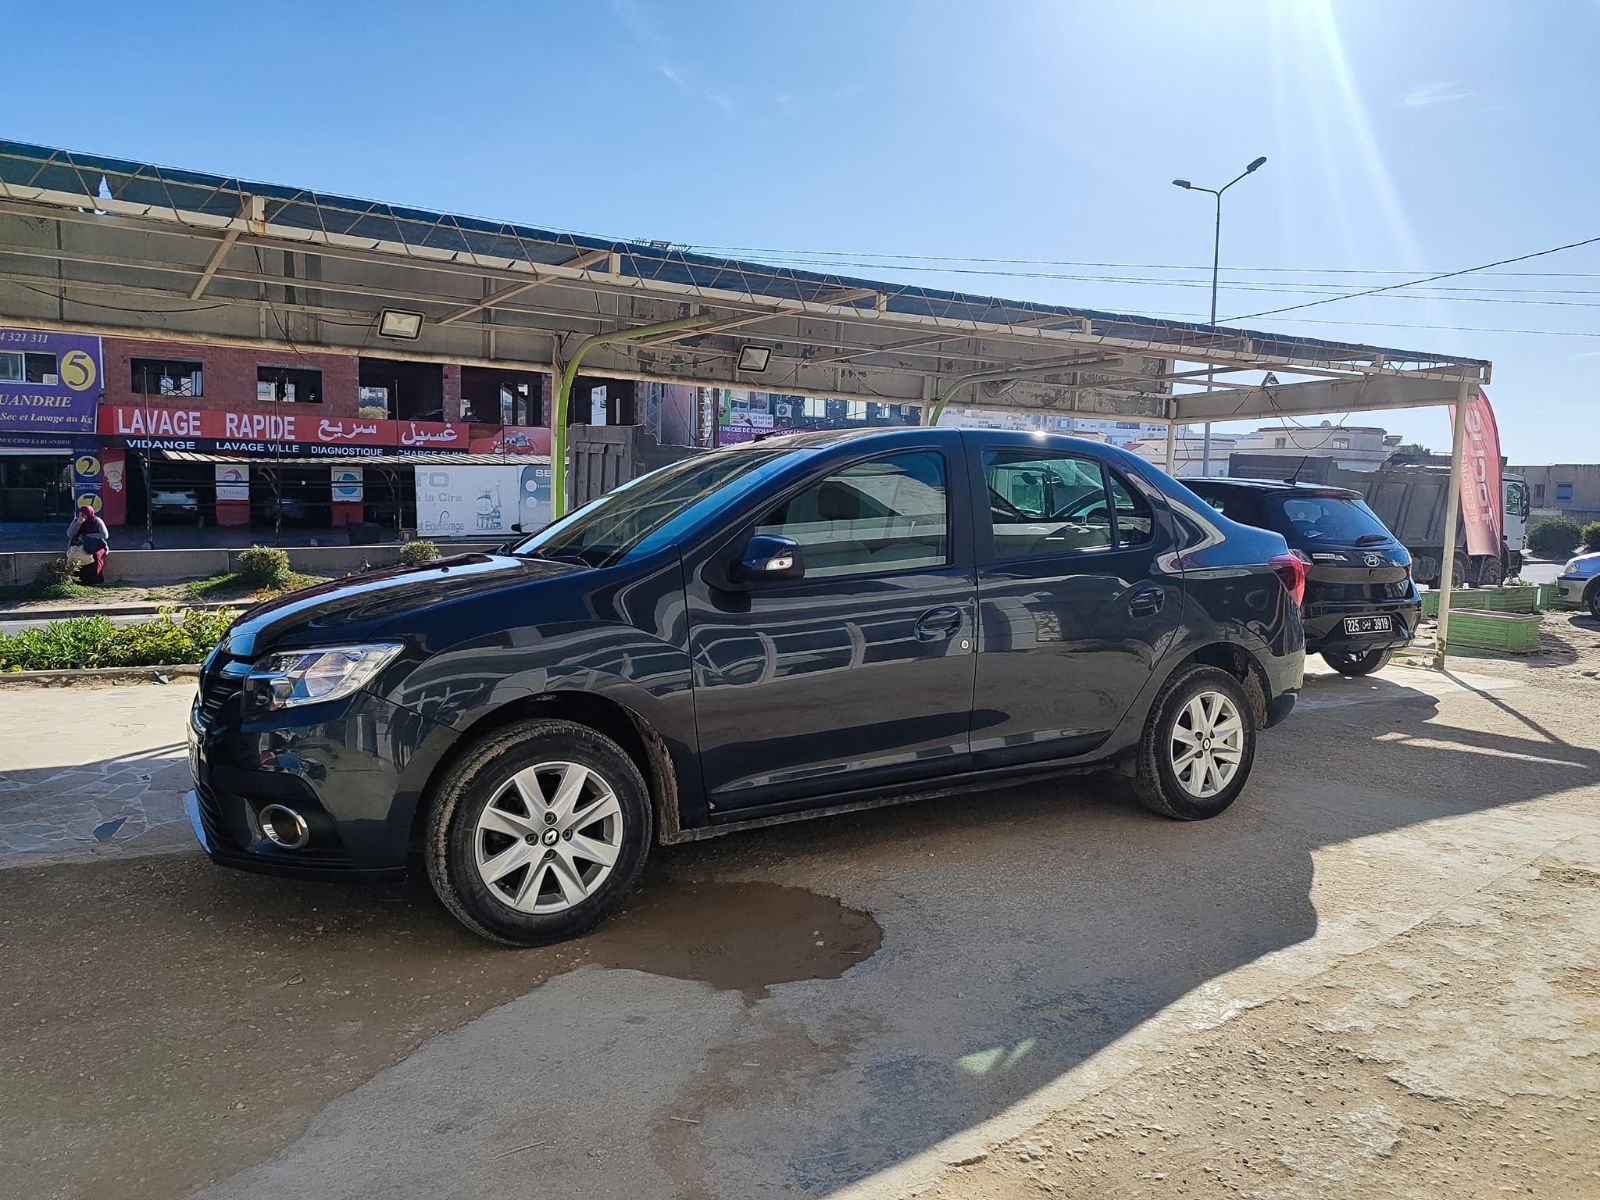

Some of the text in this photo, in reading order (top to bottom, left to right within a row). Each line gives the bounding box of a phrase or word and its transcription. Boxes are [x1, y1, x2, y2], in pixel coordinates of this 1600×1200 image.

[8, 332, 27, 341] 321
[30, 334, 48, 343] 311
[69, 354, 88, 386] 5
[0, 412, 17, 421] Sec
[30, 413, 64, 424] Lavage
[80, 415, 94, 425] Kg
[118, 408, 296, 440] LAVAGE RAPIDE
[317, 418, 458, 446] غسيل سريع
[126, 439, 196, 450] VIDANGE
[216, 441, 300, 453] LAVAGE VILLE
[311, 445, 383, 457] DIAGNOSTIQUE
[81, 458, 96, 476] 2
[438, 492, 463, 503] Cire
[1347, 620, 1360, 632] 225
[1373, 618, 1390, 630] 3919
